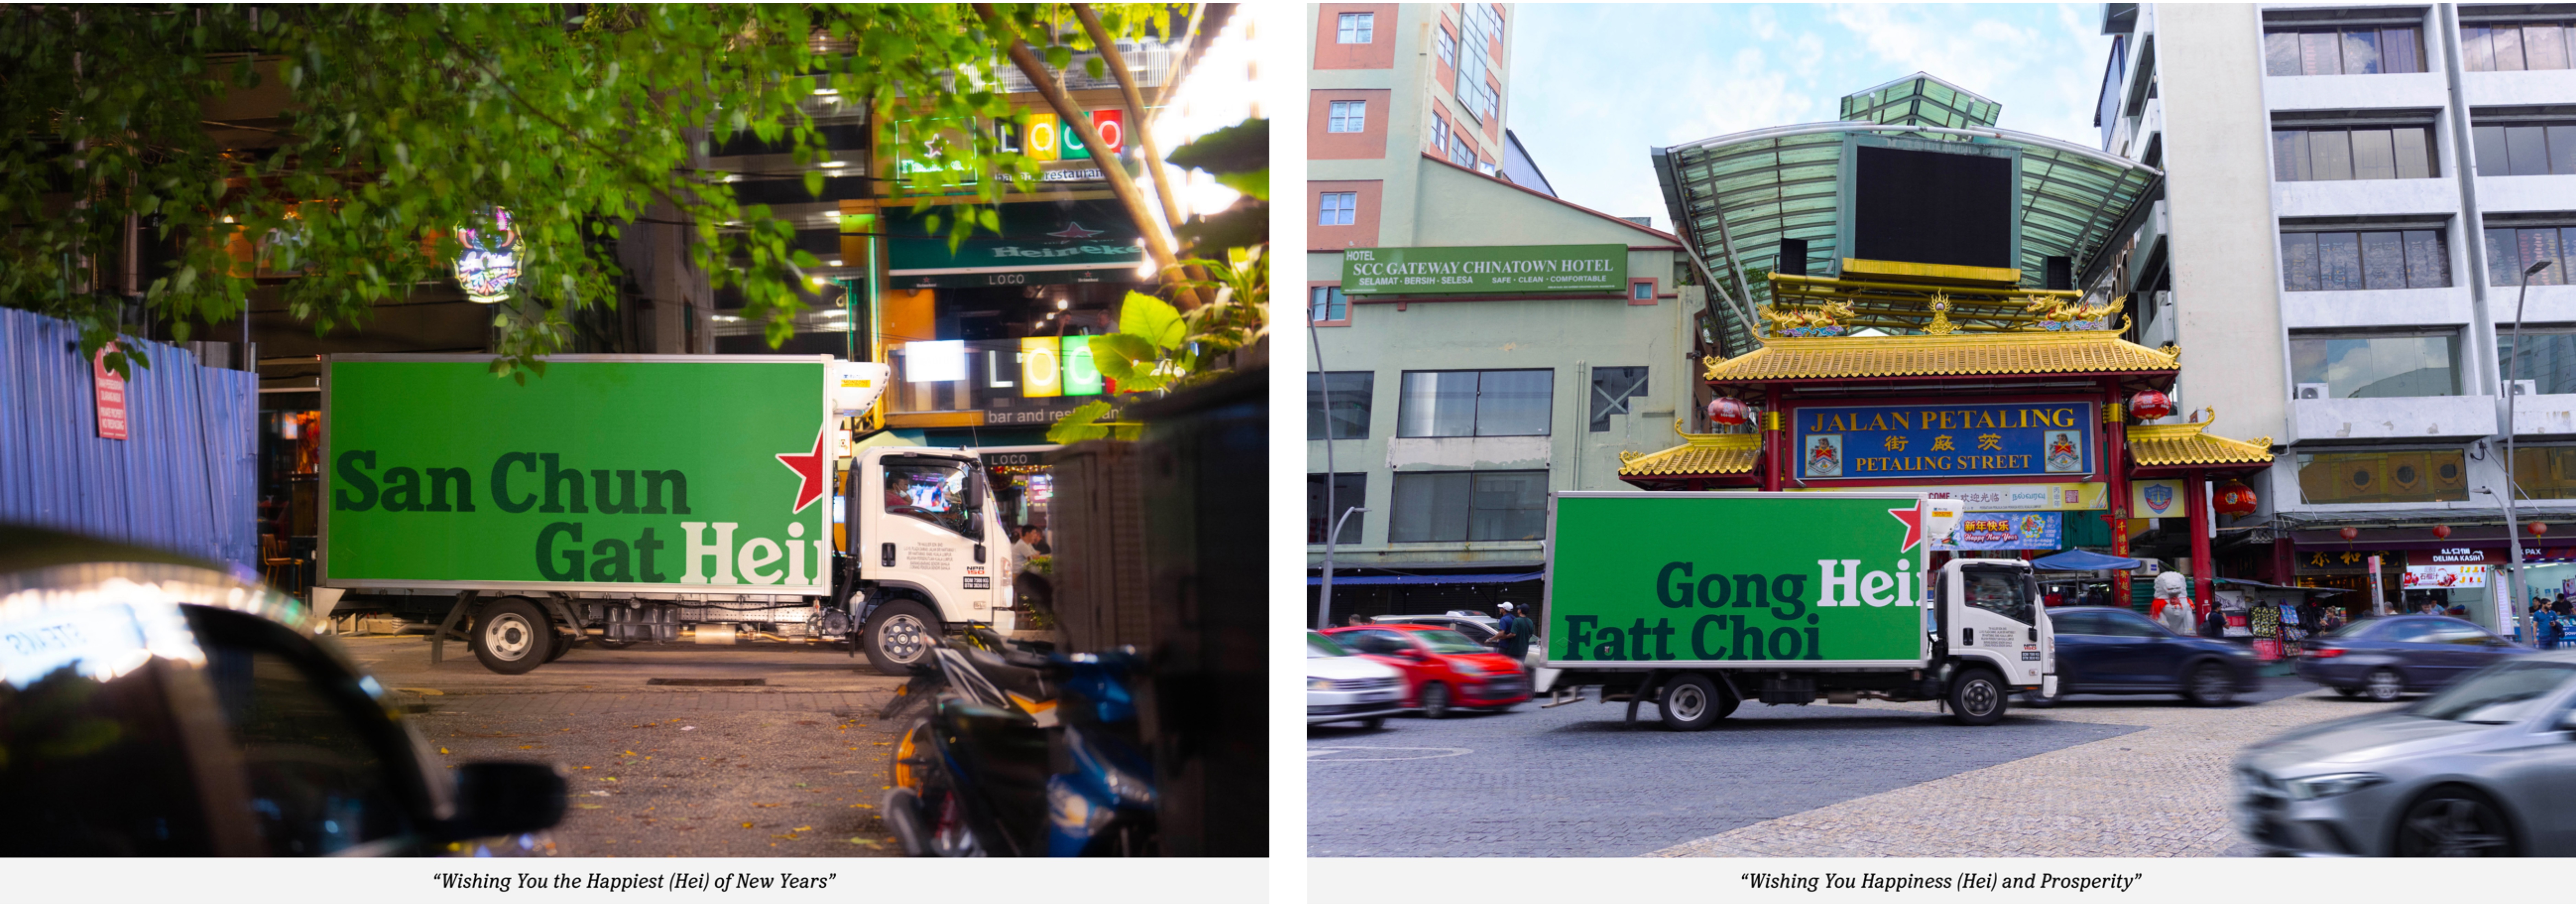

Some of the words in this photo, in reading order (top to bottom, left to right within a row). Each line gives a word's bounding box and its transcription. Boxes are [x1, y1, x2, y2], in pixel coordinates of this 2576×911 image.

[1001, 120, 1121, 152] LOCO
[996, 173, 1012, 181] ba
[1045, 168, 1104, 180] restauran
[992, 245, 1141, 258] Heineke
[1346, 251, 1375, 261] HOTEL
[1353, 263, 1383, 275] SCC
[1387, 262, 1460, 275] GATEWAY
[1463, 260, 1557, 274] CHINATOWN
[1561, 260, 1613, 272] HOTEL
[989, 275, 1025, 285] LOCO
[1359, 277, 1398, 285] SELAMAT
[1441, 276, 1473, 284] SELESA
[989, 346, 1098, 388] LOC
[988, 411, 1012, 423] bar
[1017, 410, 1044, 422] and
[1811, 411, 1910, 432] JALAN
[1921, 408, 2075, 429] PETALING
[991, 454, 1027, 465] LOCO
[1856, 457, 1952, 471] PETALING
[1957, 455, 2031, 470] STREET
[335, 451, 474, 513] San
[490, 452, 691, 514] Chun
[1959, 492, 2000, 503] 欢迎光临
[1964, 520, 2009, 532] 新年快乐
[1954, 532, 1961, 541] 4
[1965, 533, 1985, 543] Happy
[536, 522, 666, 583] Gat
[1657, 561, 1808, 620] Gong
[1562, 615, 1676, 660] Fatt
[1691, 613, 1823, 660] Choi
